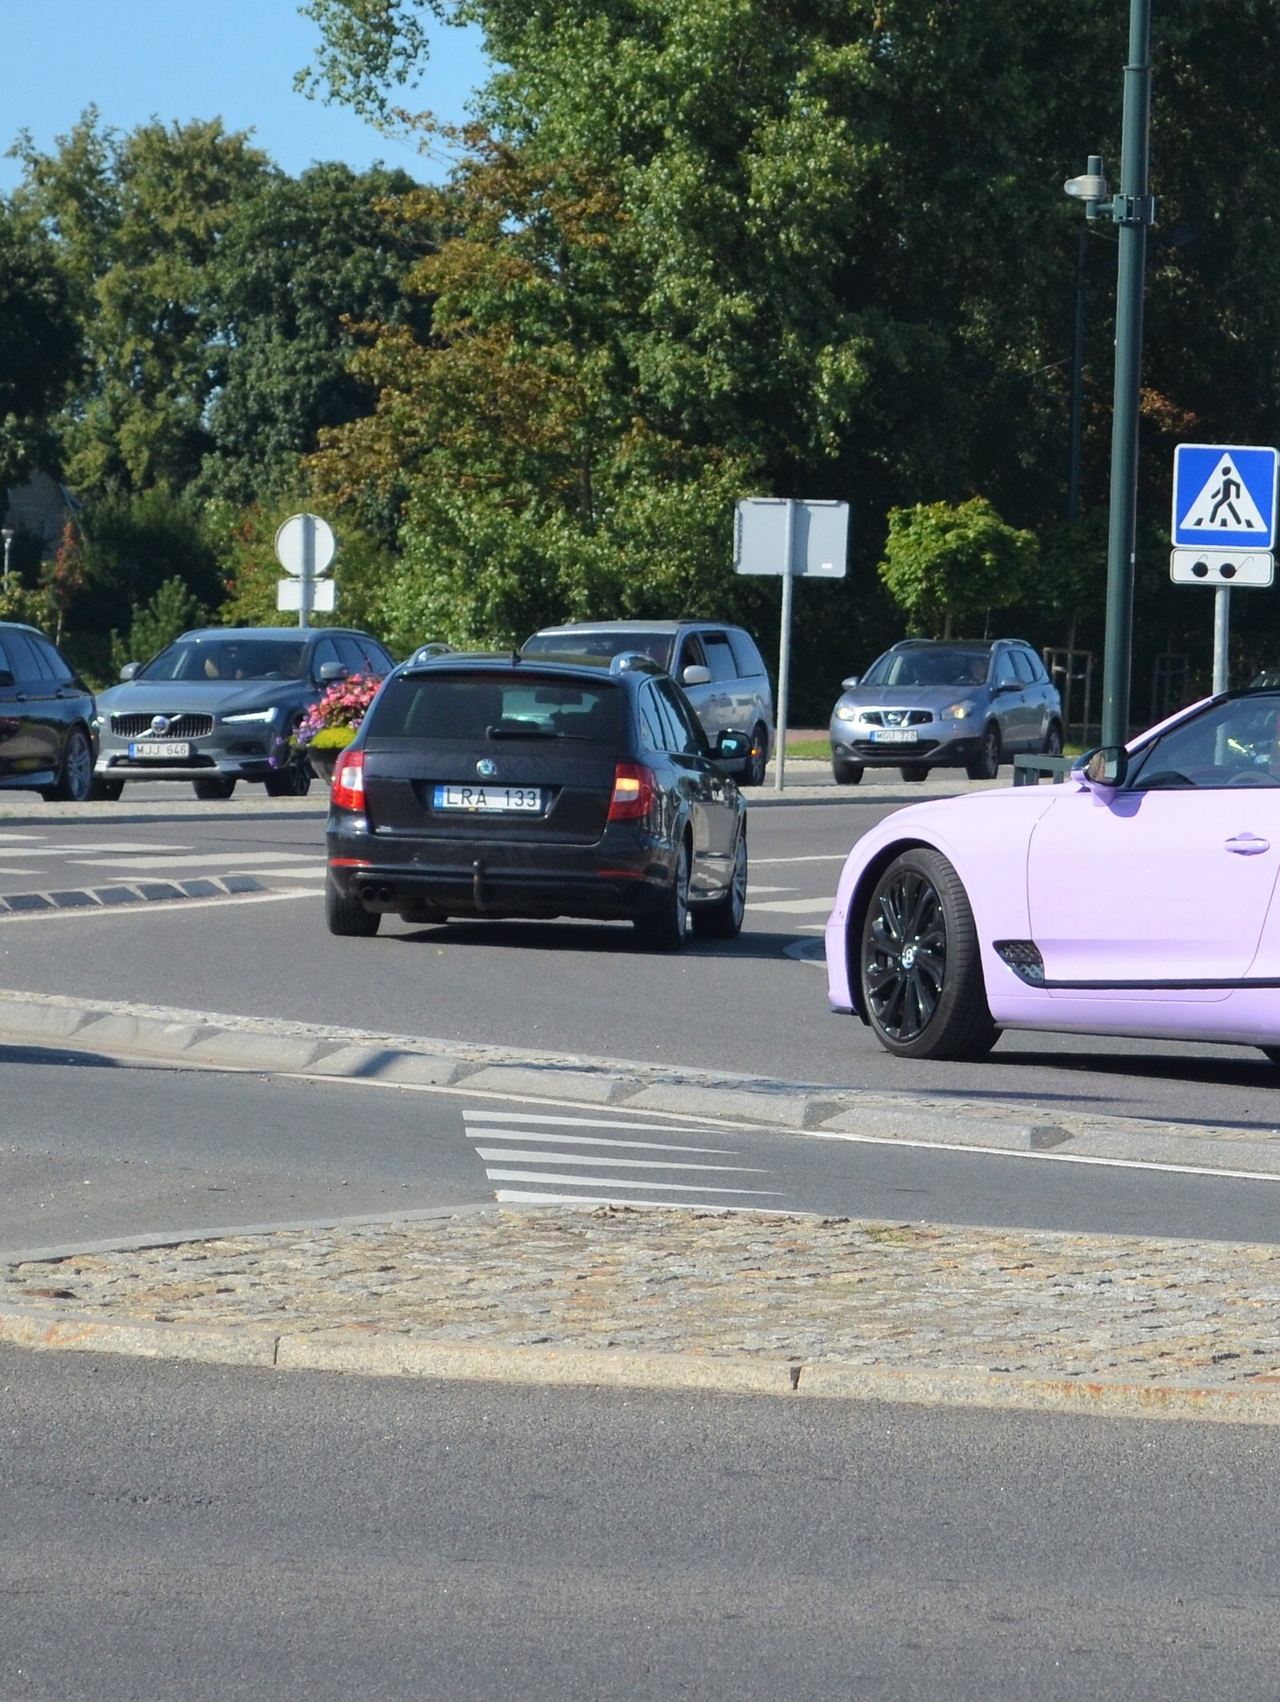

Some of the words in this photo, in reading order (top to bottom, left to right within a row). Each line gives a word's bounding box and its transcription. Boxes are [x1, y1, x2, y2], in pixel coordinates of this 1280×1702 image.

[136, 745, 160, 755] MJJ
[166, 745, 186, 755] 646
[446, 788, 487, 805] LRA
[505, 790, 537, 807] 133
